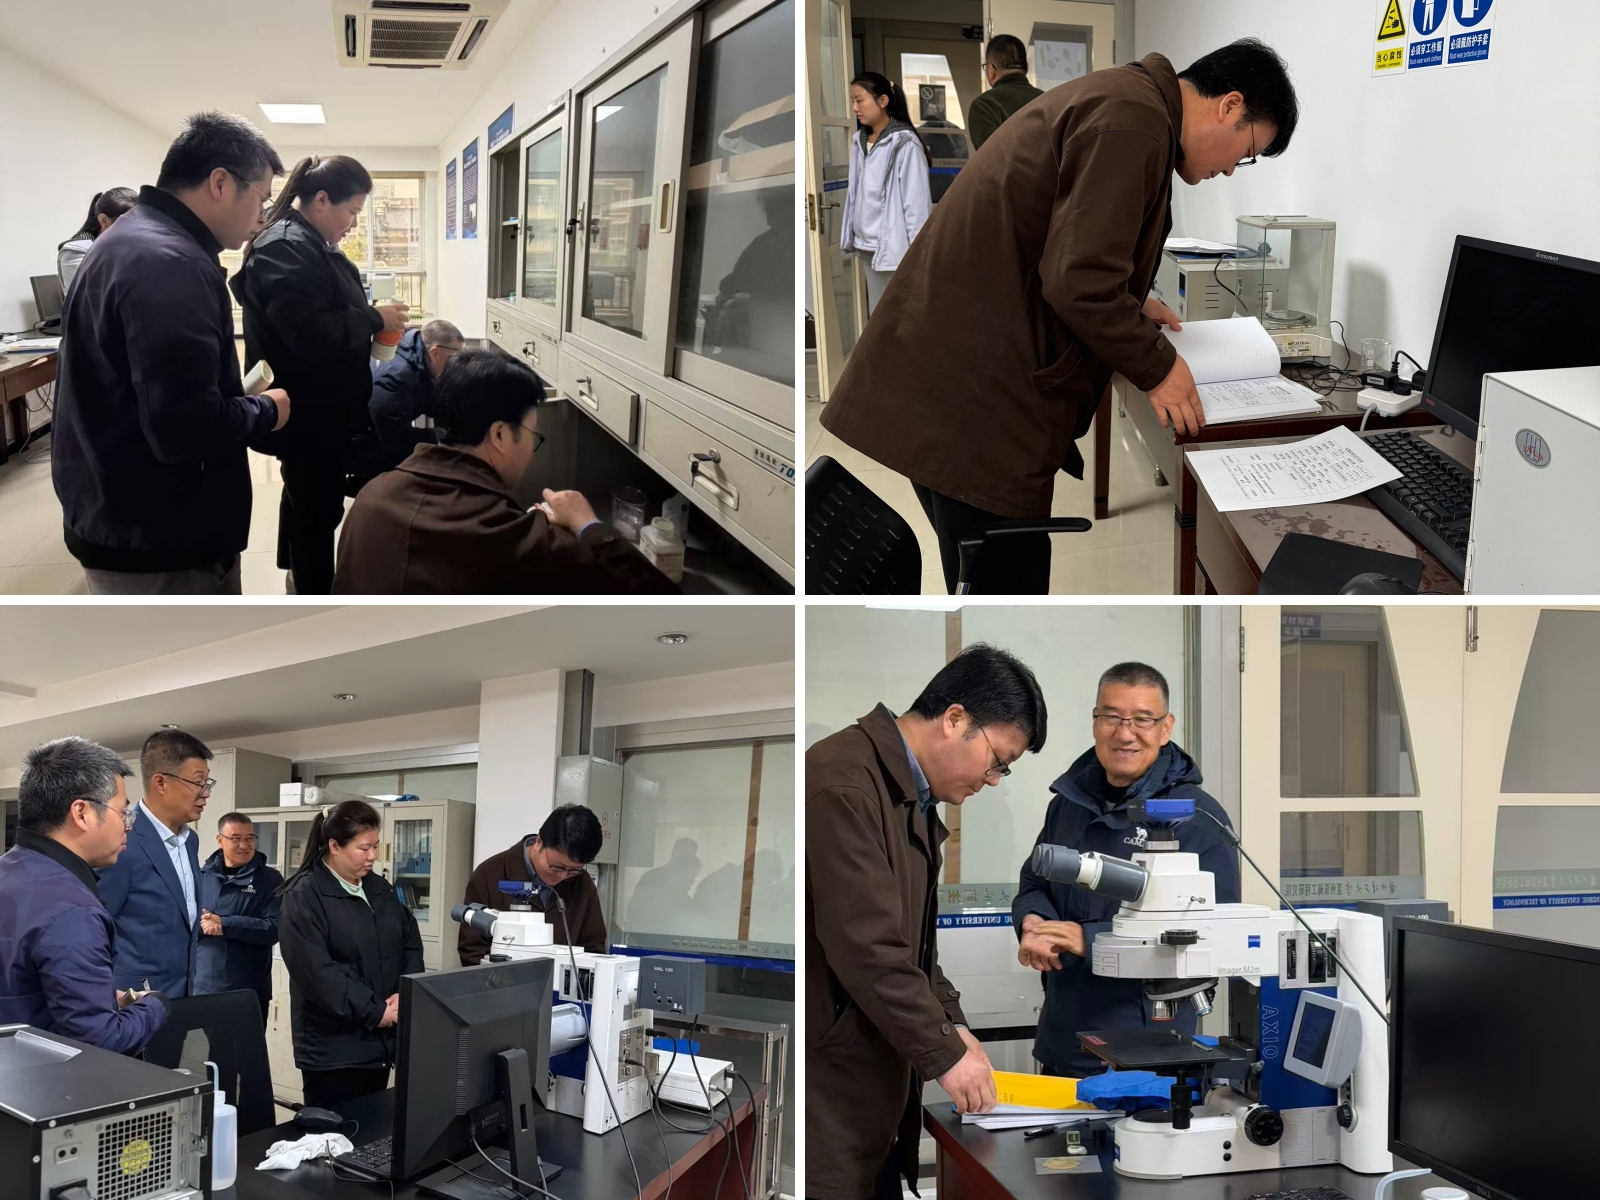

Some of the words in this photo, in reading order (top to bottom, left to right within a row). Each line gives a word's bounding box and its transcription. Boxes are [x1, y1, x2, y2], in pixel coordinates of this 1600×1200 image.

[1410, 41, 1443, 57] 必须穿工作服
[1450, 33, 1489, 50] 必须戴防护手套
[1376, 50, 1402, 63] 当心腐蚀
[1535, 252, 1559, 261] lenovo
[1262, 1004, 1279, 1059] AXIO
